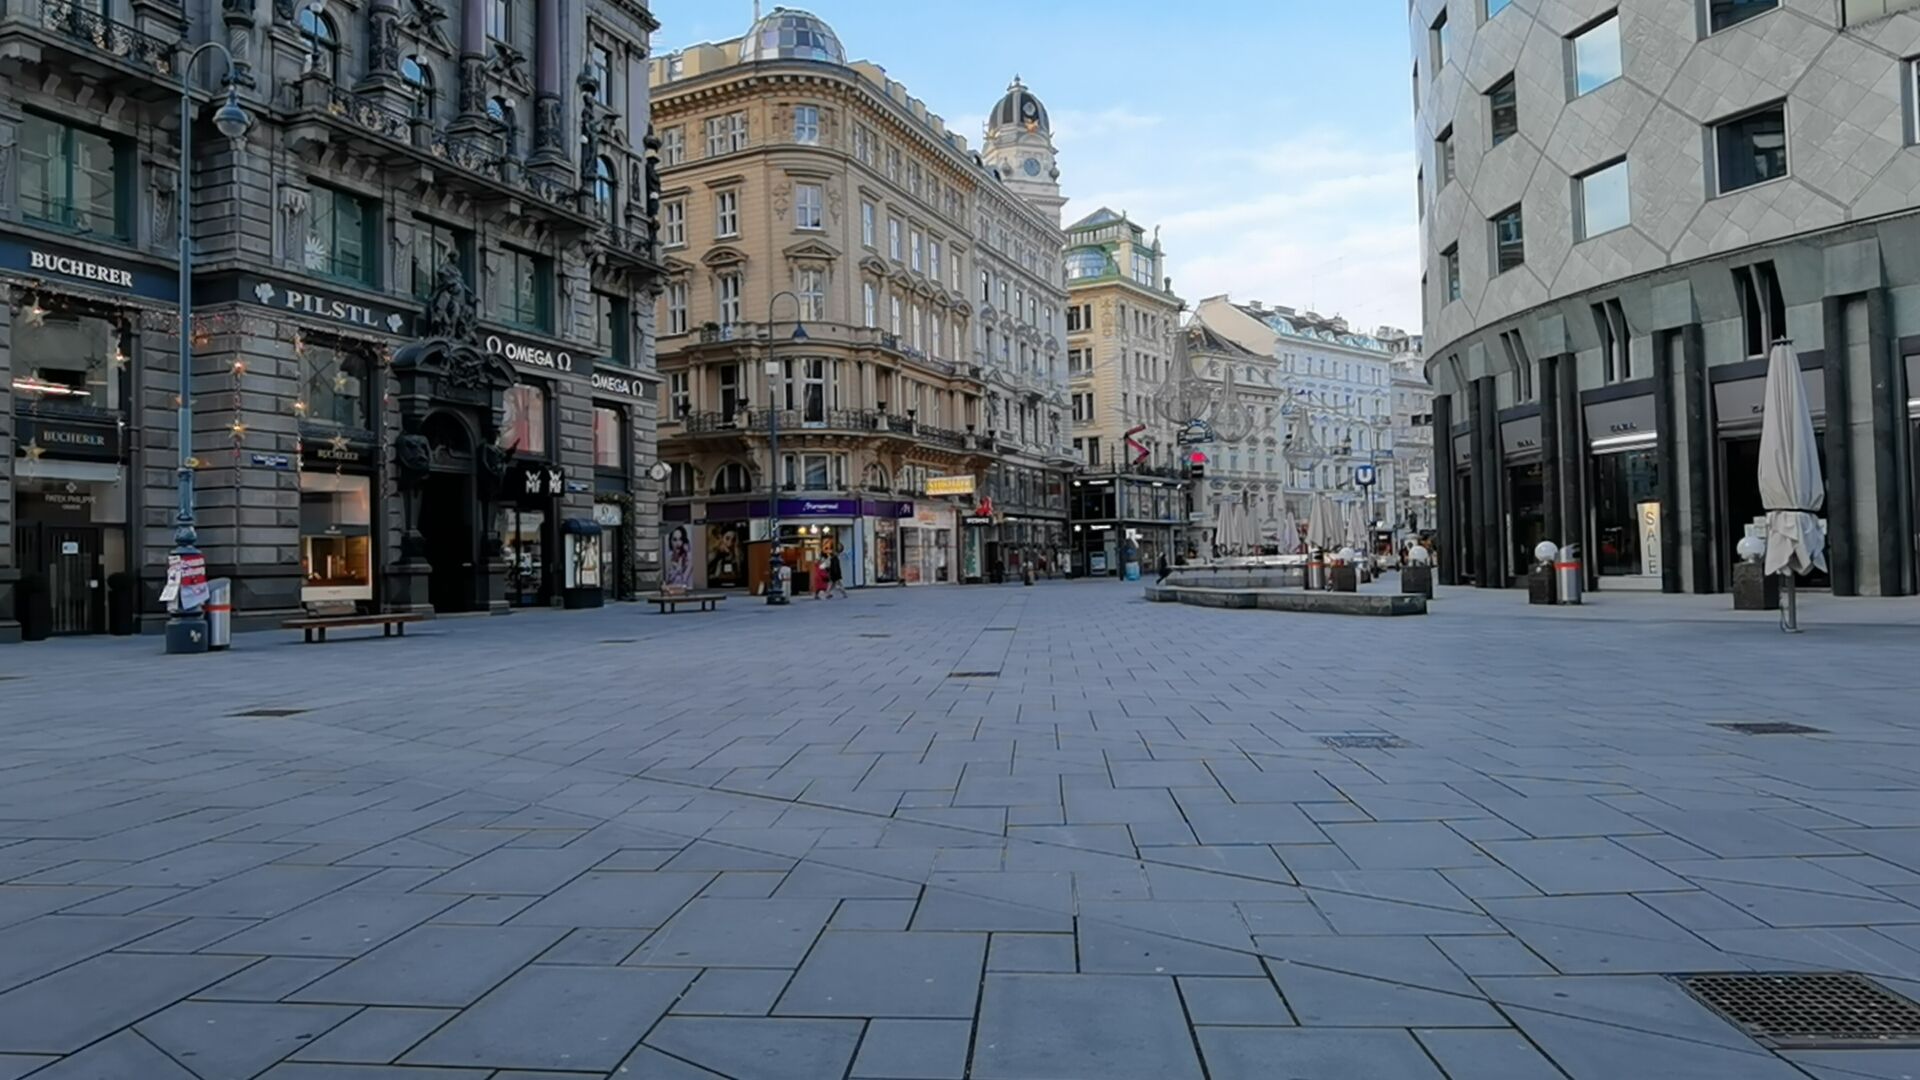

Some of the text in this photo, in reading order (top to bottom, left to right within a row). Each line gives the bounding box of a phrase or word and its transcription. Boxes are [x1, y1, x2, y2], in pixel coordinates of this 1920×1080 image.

[29, 250, 133, 287] BUCHERER
[286, 289, 378, 327] PILSTL
[505, 343, 554, 368] OMEGA
[591, 373, 630, 393] OMEGA
[43, 431, 104, 446] BUCHERER
[1358, 468, 1372, 483] U
[1645, 511, 1658, 574] SALE
